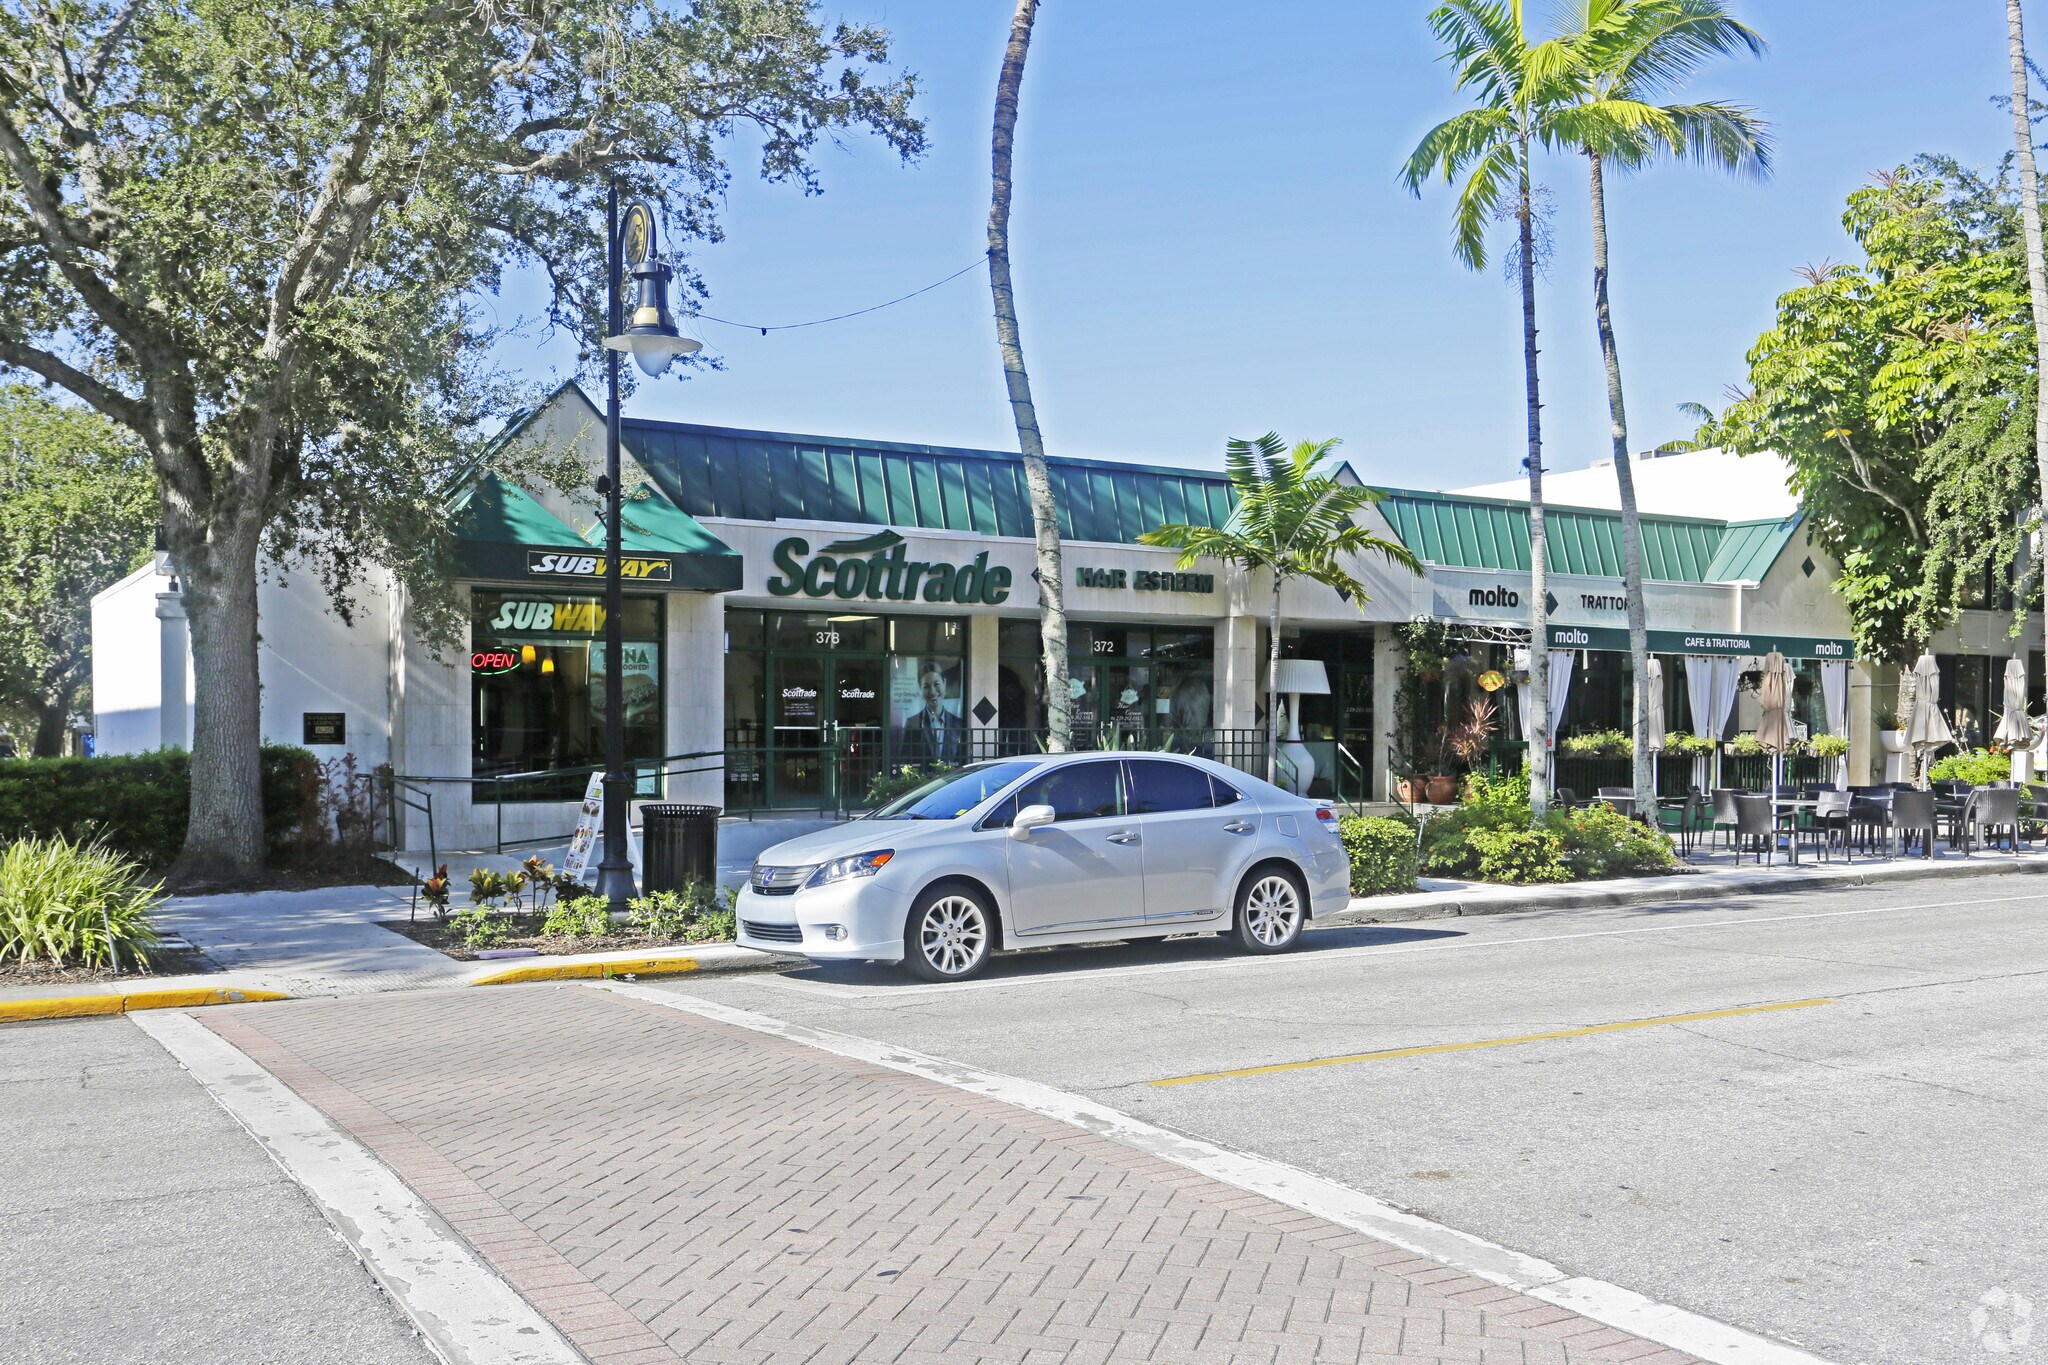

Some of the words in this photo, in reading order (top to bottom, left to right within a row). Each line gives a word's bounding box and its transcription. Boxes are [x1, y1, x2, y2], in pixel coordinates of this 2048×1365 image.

[767, 537, 1012, 605] Scottrade
[1076, 567, 1127, 589] HAIR
[1133, 570, 1214, 593] ESTEEM
[1469, 585, 1519, 608] molto
[1580, 594, 1627, 611] TRATTO
[816, 632, 840, 644] 378
[1555, 628, 1589, 644] molto
[1685, 637, 1705, 647] CAFE
[1706, 638, 1712, 647] &
[1712, 638, 1751, 649] TRATTORIA
[1093, 641, 1114, 652] 372
[1815, 641, 1843, 655] molto
[472, 653, 515, 667] OPEN
[600, 648, 649, 663] TNA
[782, 687, 817, 698] Scottrade
[841, 688, 875, 698] Scottrade
